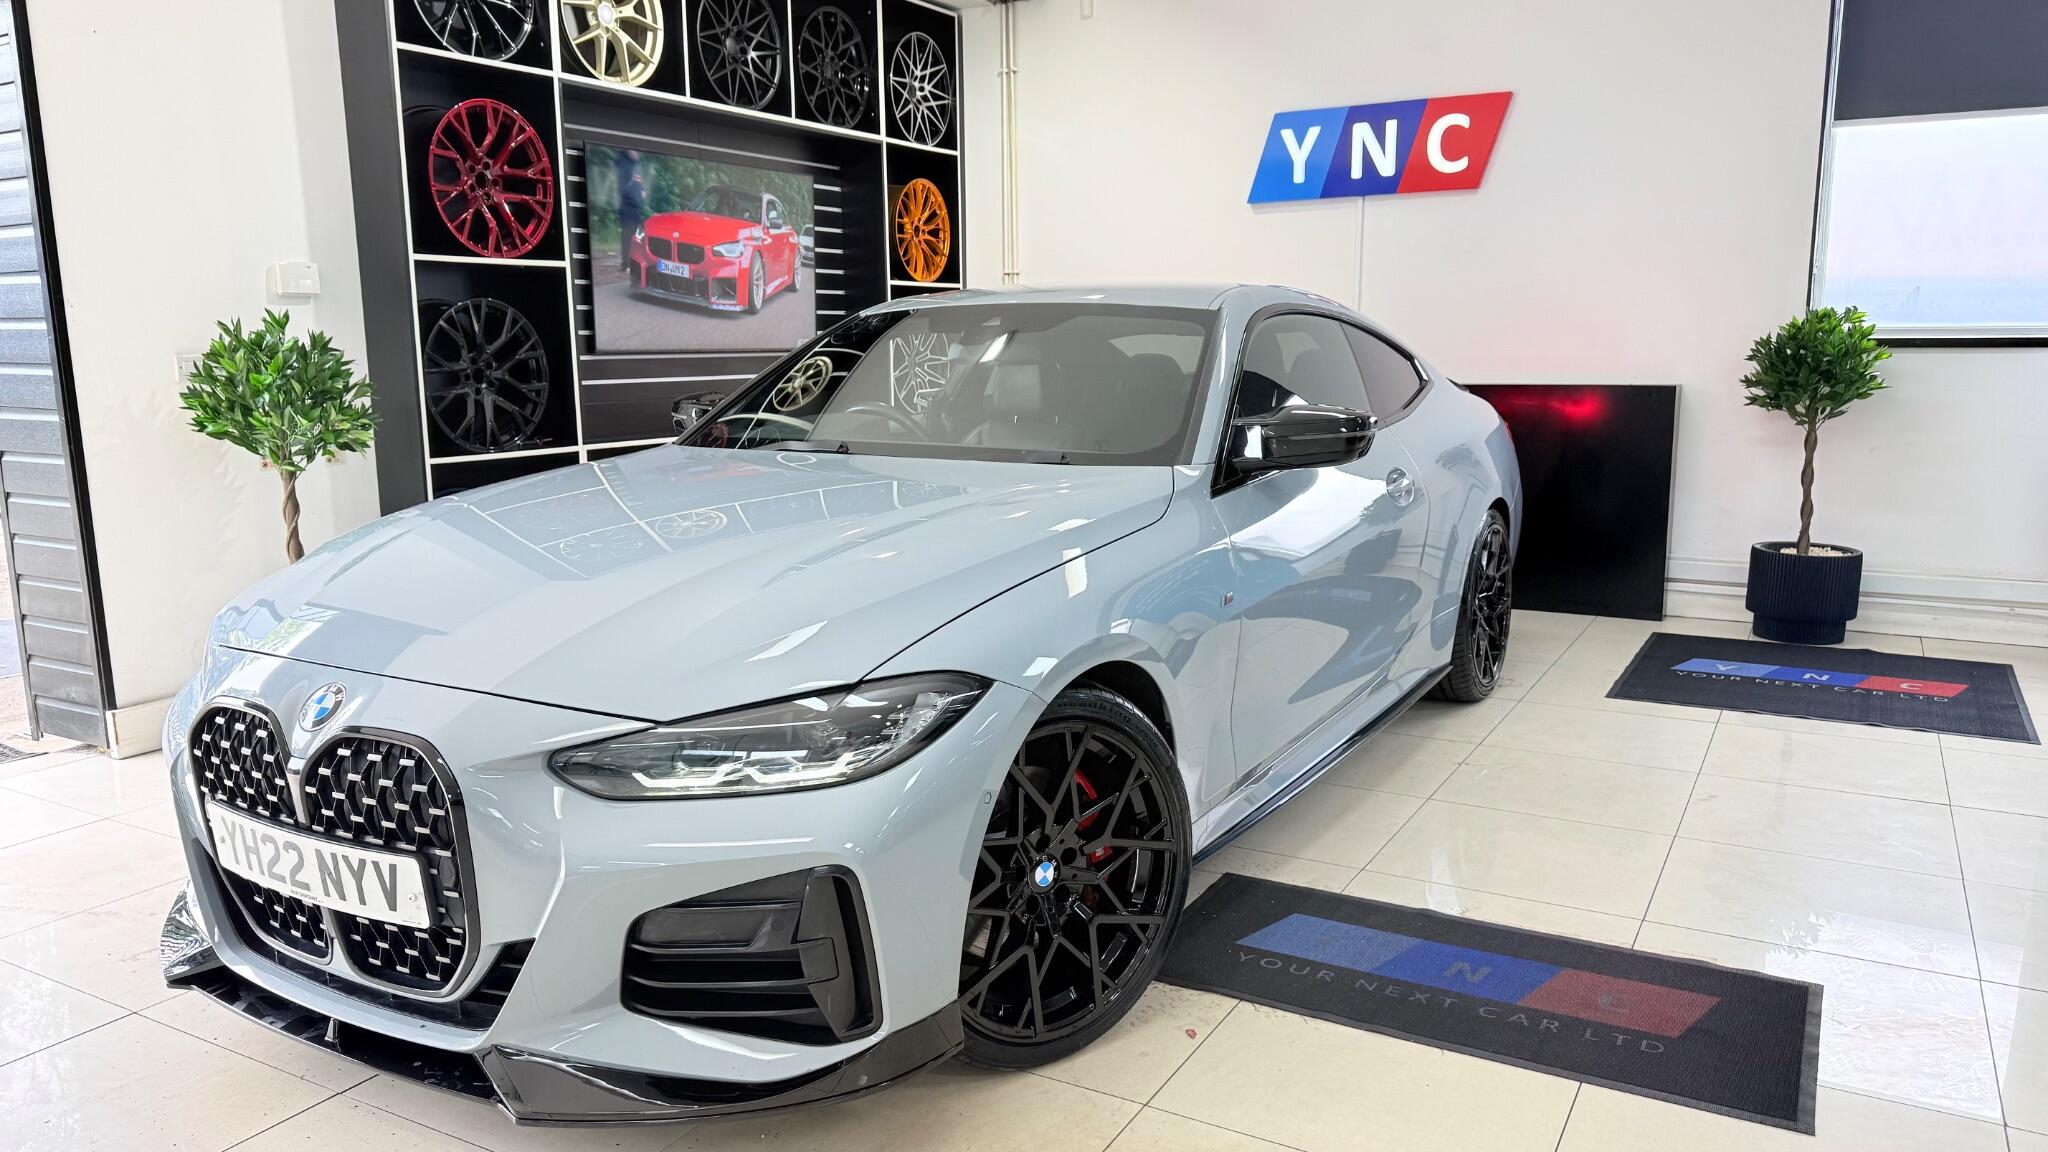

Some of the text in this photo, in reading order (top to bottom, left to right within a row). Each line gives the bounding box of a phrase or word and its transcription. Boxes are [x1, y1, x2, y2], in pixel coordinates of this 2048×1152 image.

[1280, 113, 1470, 183] YNC
[1676, 671, 1949, 702] YOUR NEXT CAR LTD
[221, 816, 398, 912] YH22 NYV
[1238, 952, 1666, 1053] YOUR NEXT CAR LTD
